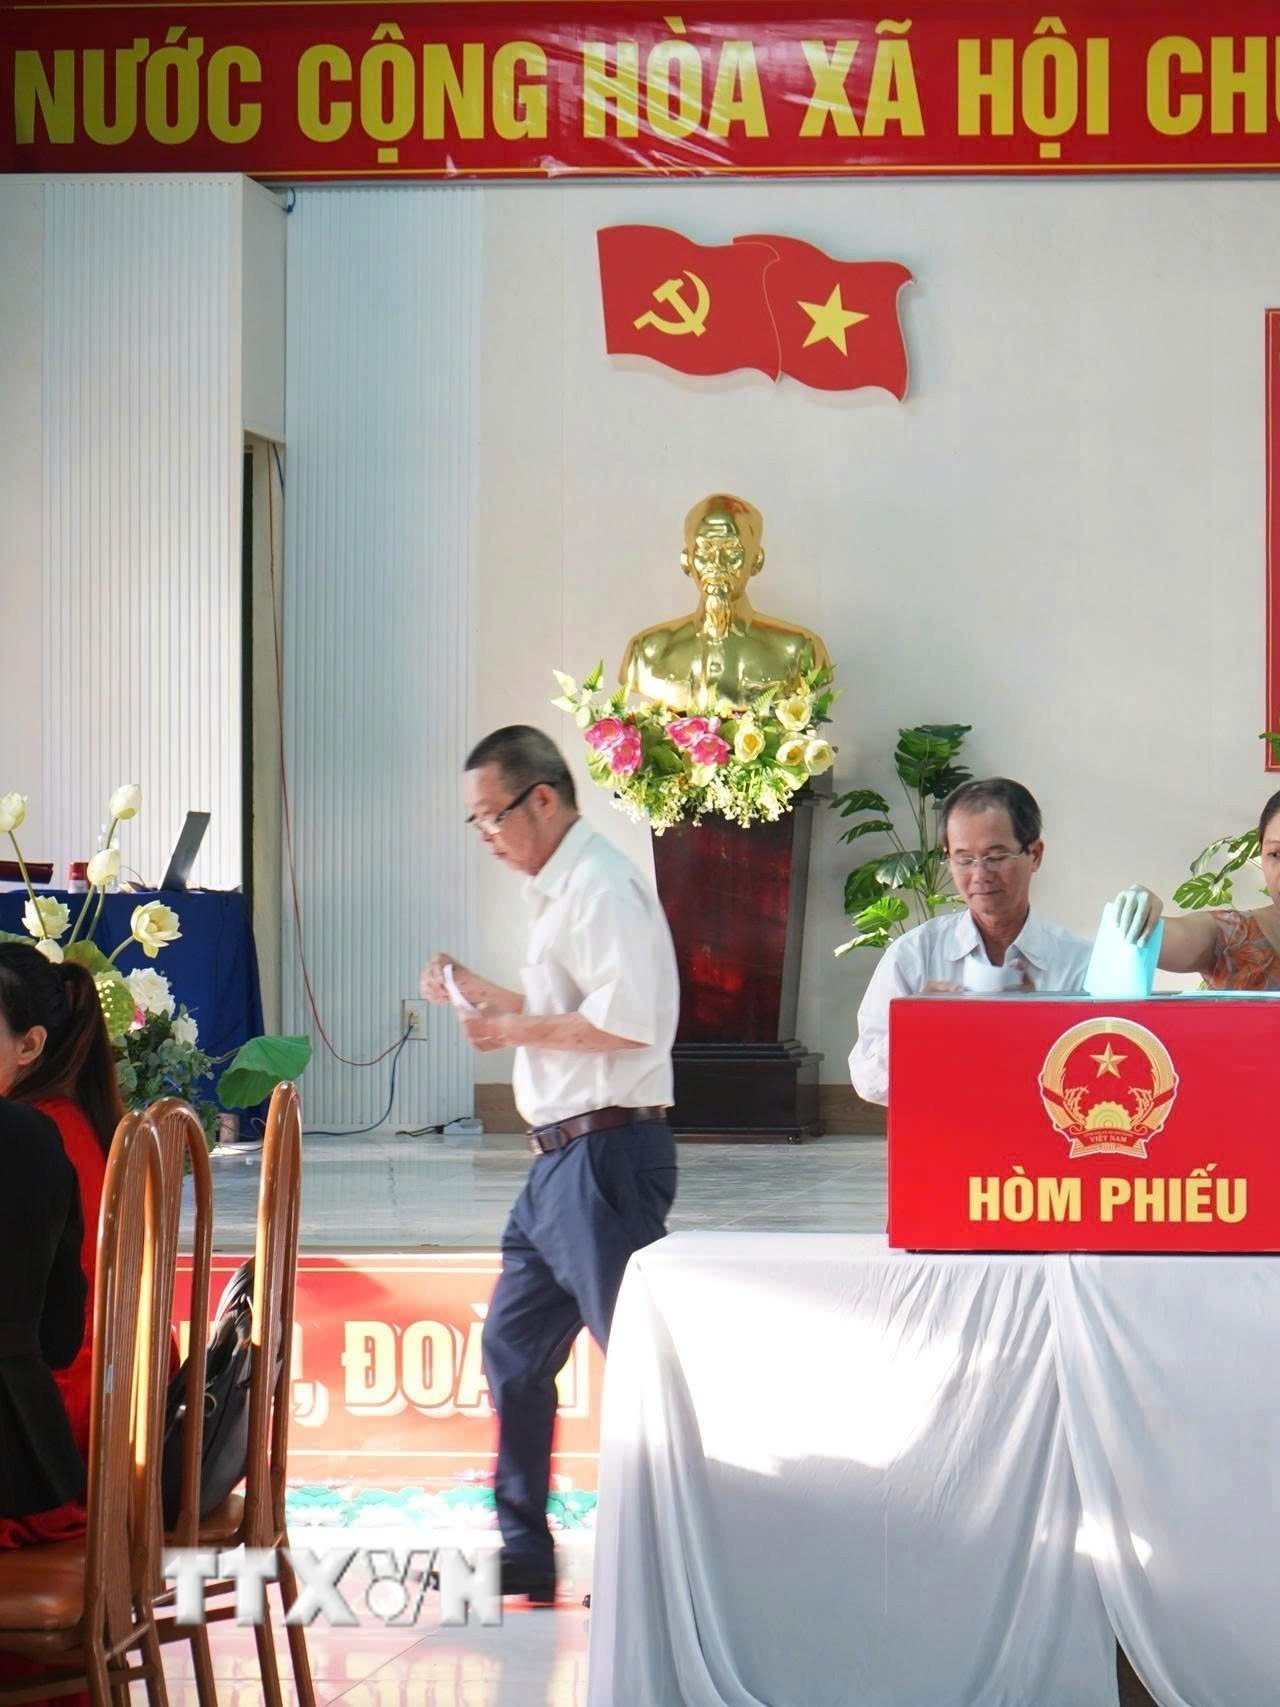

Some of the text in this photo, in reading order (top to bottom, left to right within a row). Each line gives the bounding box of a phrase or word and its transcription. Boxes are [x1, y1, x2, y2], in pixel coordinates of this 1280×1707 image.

[14, 26, 262, 145] NƯỚC
[298, 23, 548, 163] CỘNG
[583, 17, 769, 138] HÒA
[799, 19, 925, 137] XÃ
[957, 17, 1109, 158] HỘI
[969, 1163, 1248, 1223] HÒM PHIẾU
